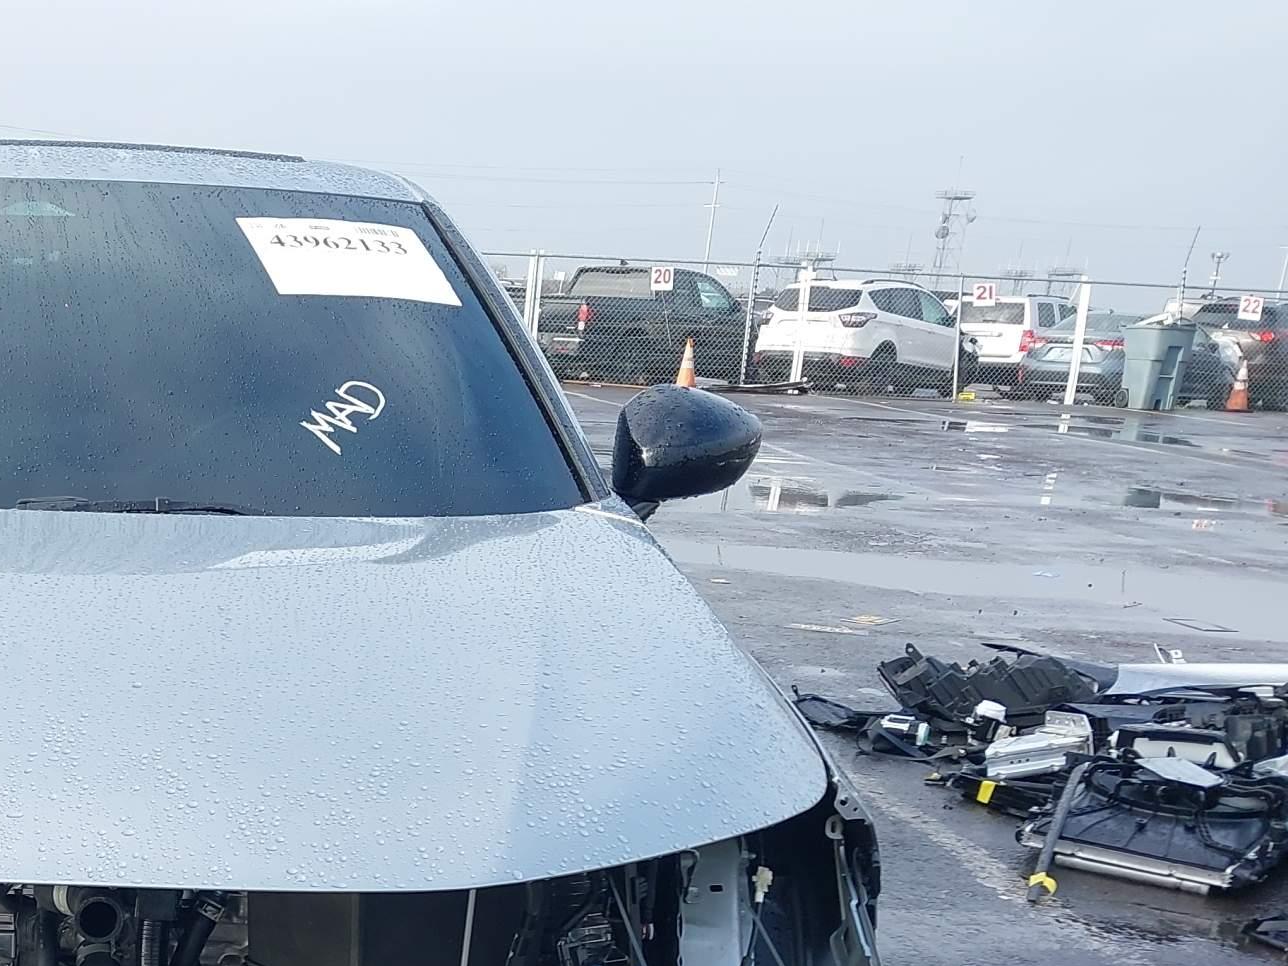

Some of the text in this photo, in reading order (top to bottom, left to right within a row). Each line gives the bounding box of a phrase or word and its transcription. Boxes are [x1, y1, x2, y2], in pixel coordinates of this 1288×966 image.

[269, 234, 408, 255] 43962133
[654, 268, 672, 284] 20
[976, 285, 994, 300] 21
[1242, 298, 1261, 314] 22
[298, 380, 386, 456] MAD
